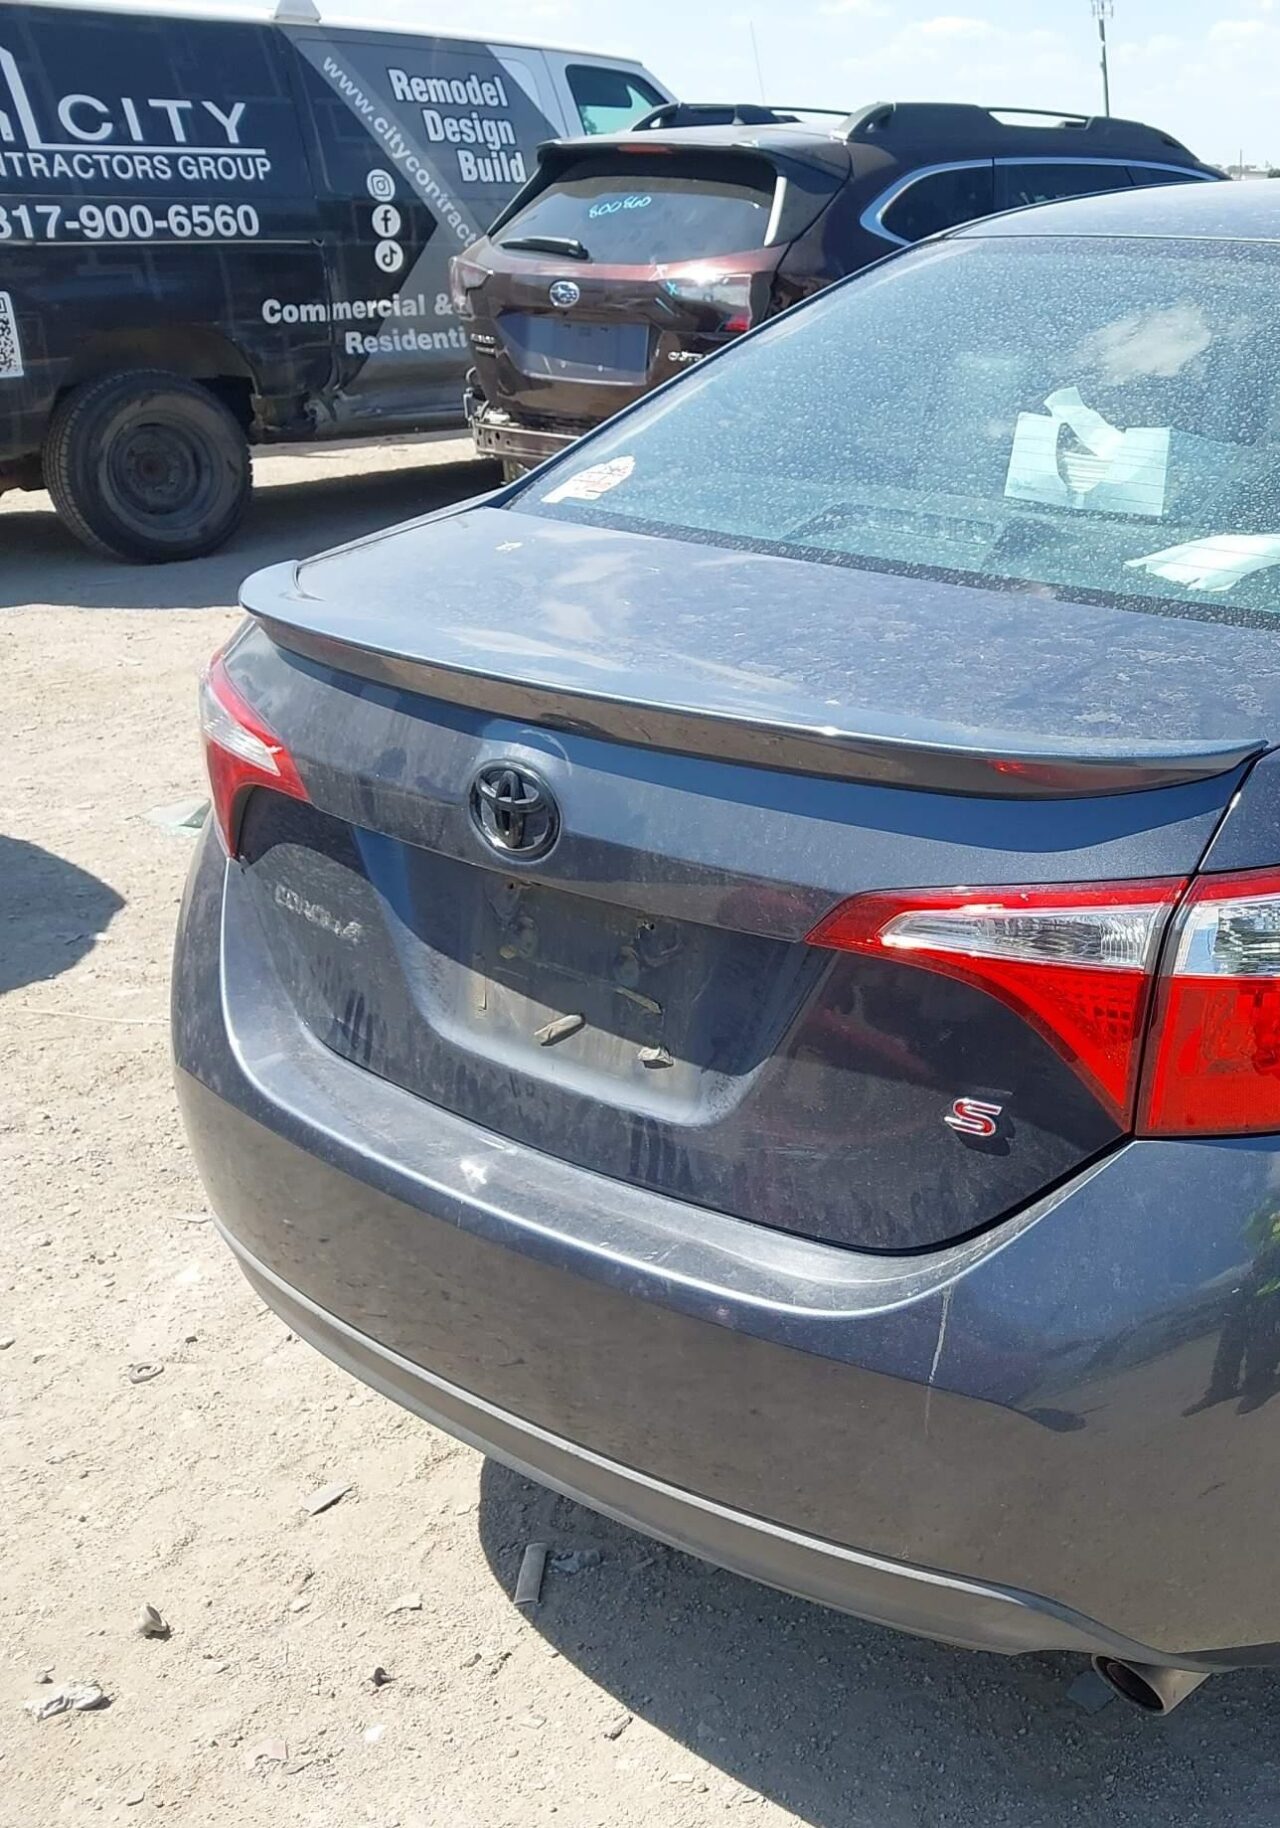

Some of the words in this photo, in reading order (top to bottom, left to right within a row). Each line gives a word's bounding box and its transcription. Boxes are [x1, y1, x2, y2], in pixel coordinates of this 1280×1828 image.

[387, 68, 509, 107] Remodel
[57, 94, 246, 144] CITY
[422, 108, 516, 151] Design
[177, 156, 272, 181] GROUP
[456, 149, 528, 184] Build
[262, 293, 426, 324] Commercial
[434, 293, 454, 315] &
[345, 326, 468, 355] Residenti
[943, 1097, 1003, 1137] S
